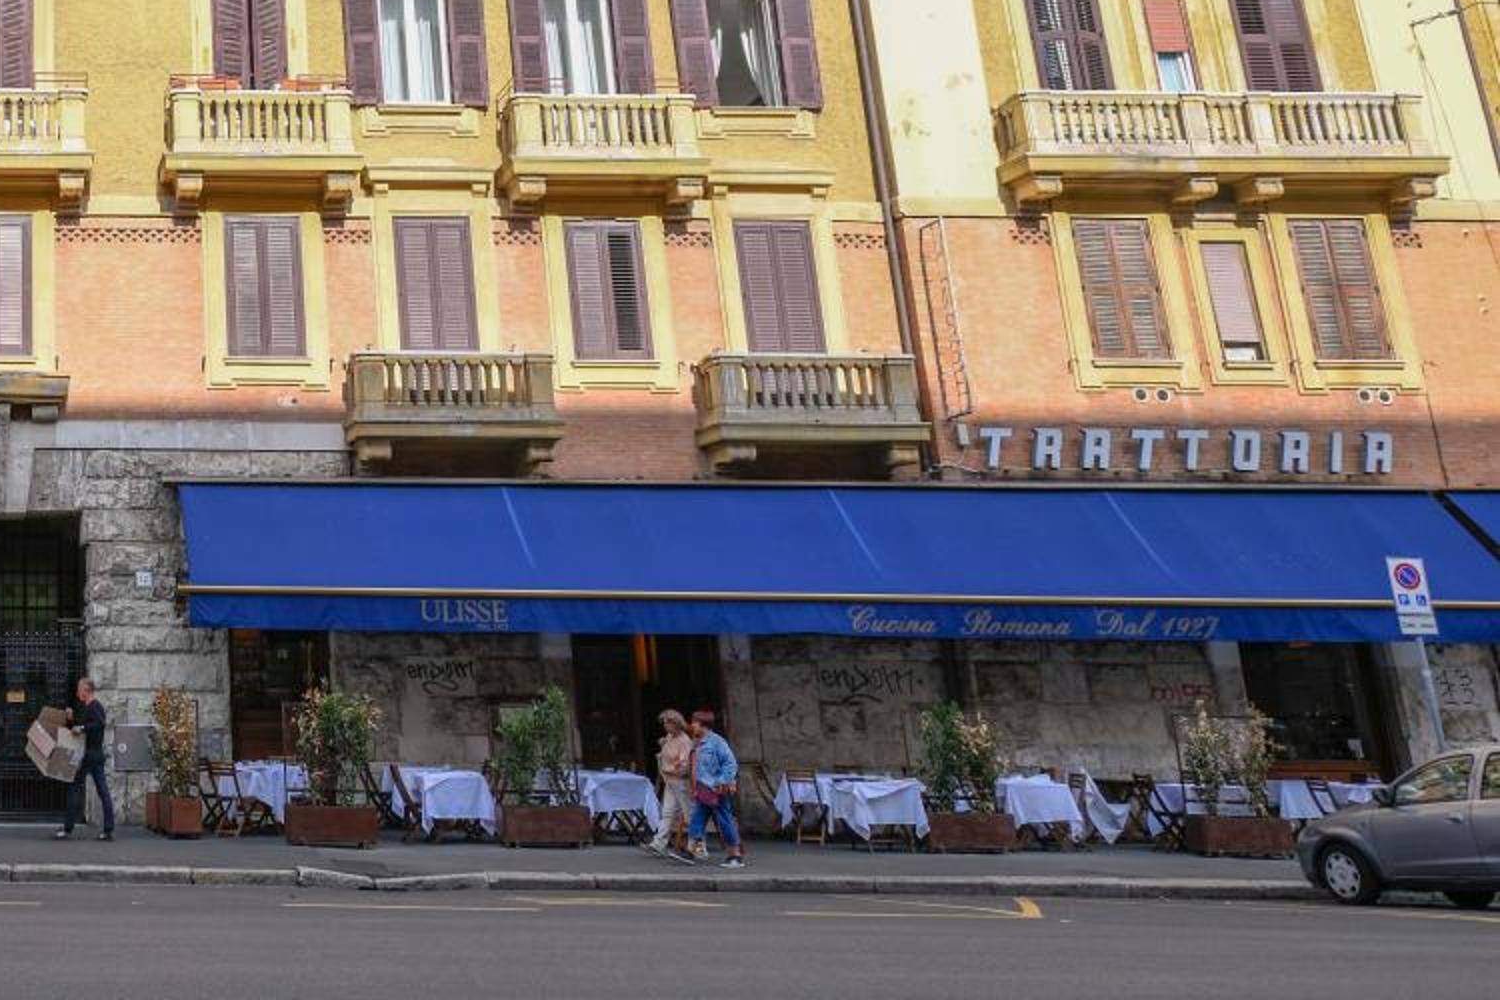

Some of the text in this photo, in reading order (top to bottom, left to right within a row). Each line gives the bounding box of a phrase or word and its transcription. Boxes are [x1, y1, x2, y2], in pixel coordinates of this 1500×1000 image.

[978, 427, 1395, 474] TRATTORIA
[420, 600, 509, 623] ULISSE
[849, 605, 1220, 638] Cucina Romana Dal 1927
